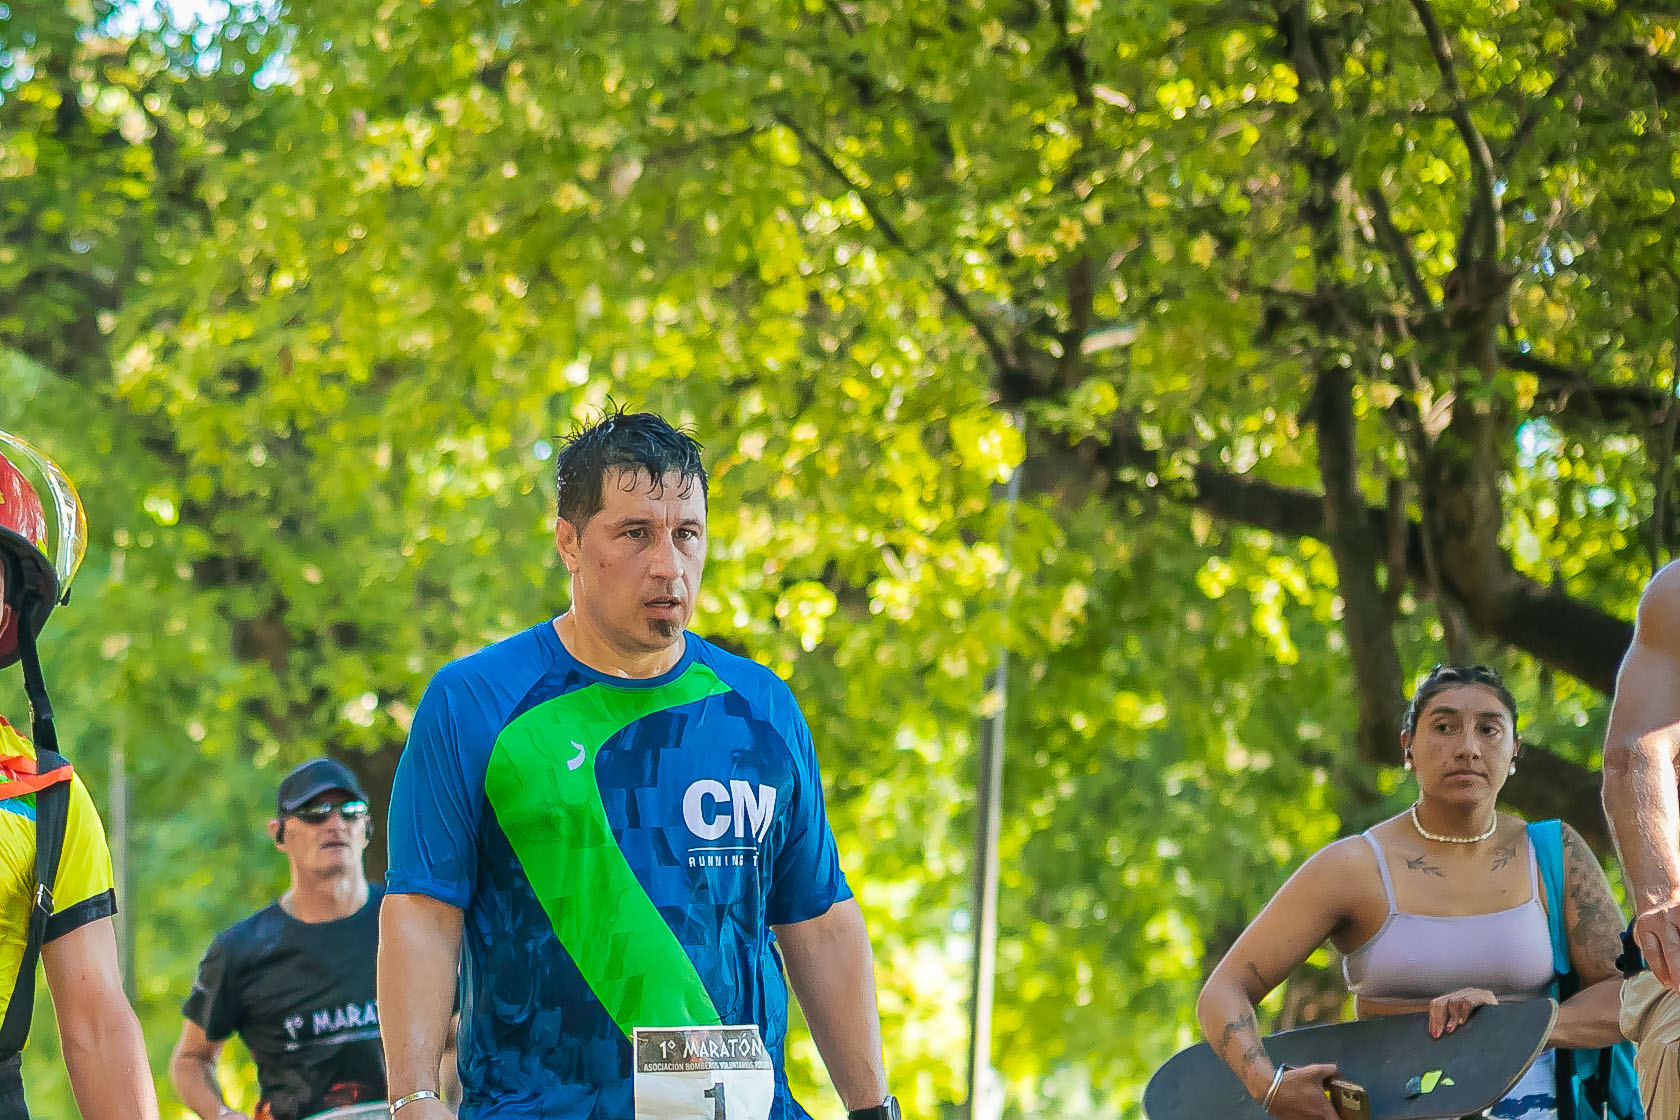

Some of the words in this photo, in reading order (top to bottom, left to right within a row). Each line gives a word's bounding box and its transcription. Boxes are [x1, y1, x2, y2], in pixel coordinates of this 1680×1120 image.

[682, 779, 778, 844] CM
[688, 854, 744, 868] RUNNING
[312, 1000, 380, 1036] MARA
[682, 1033, 764, 1059] MARATÓN
